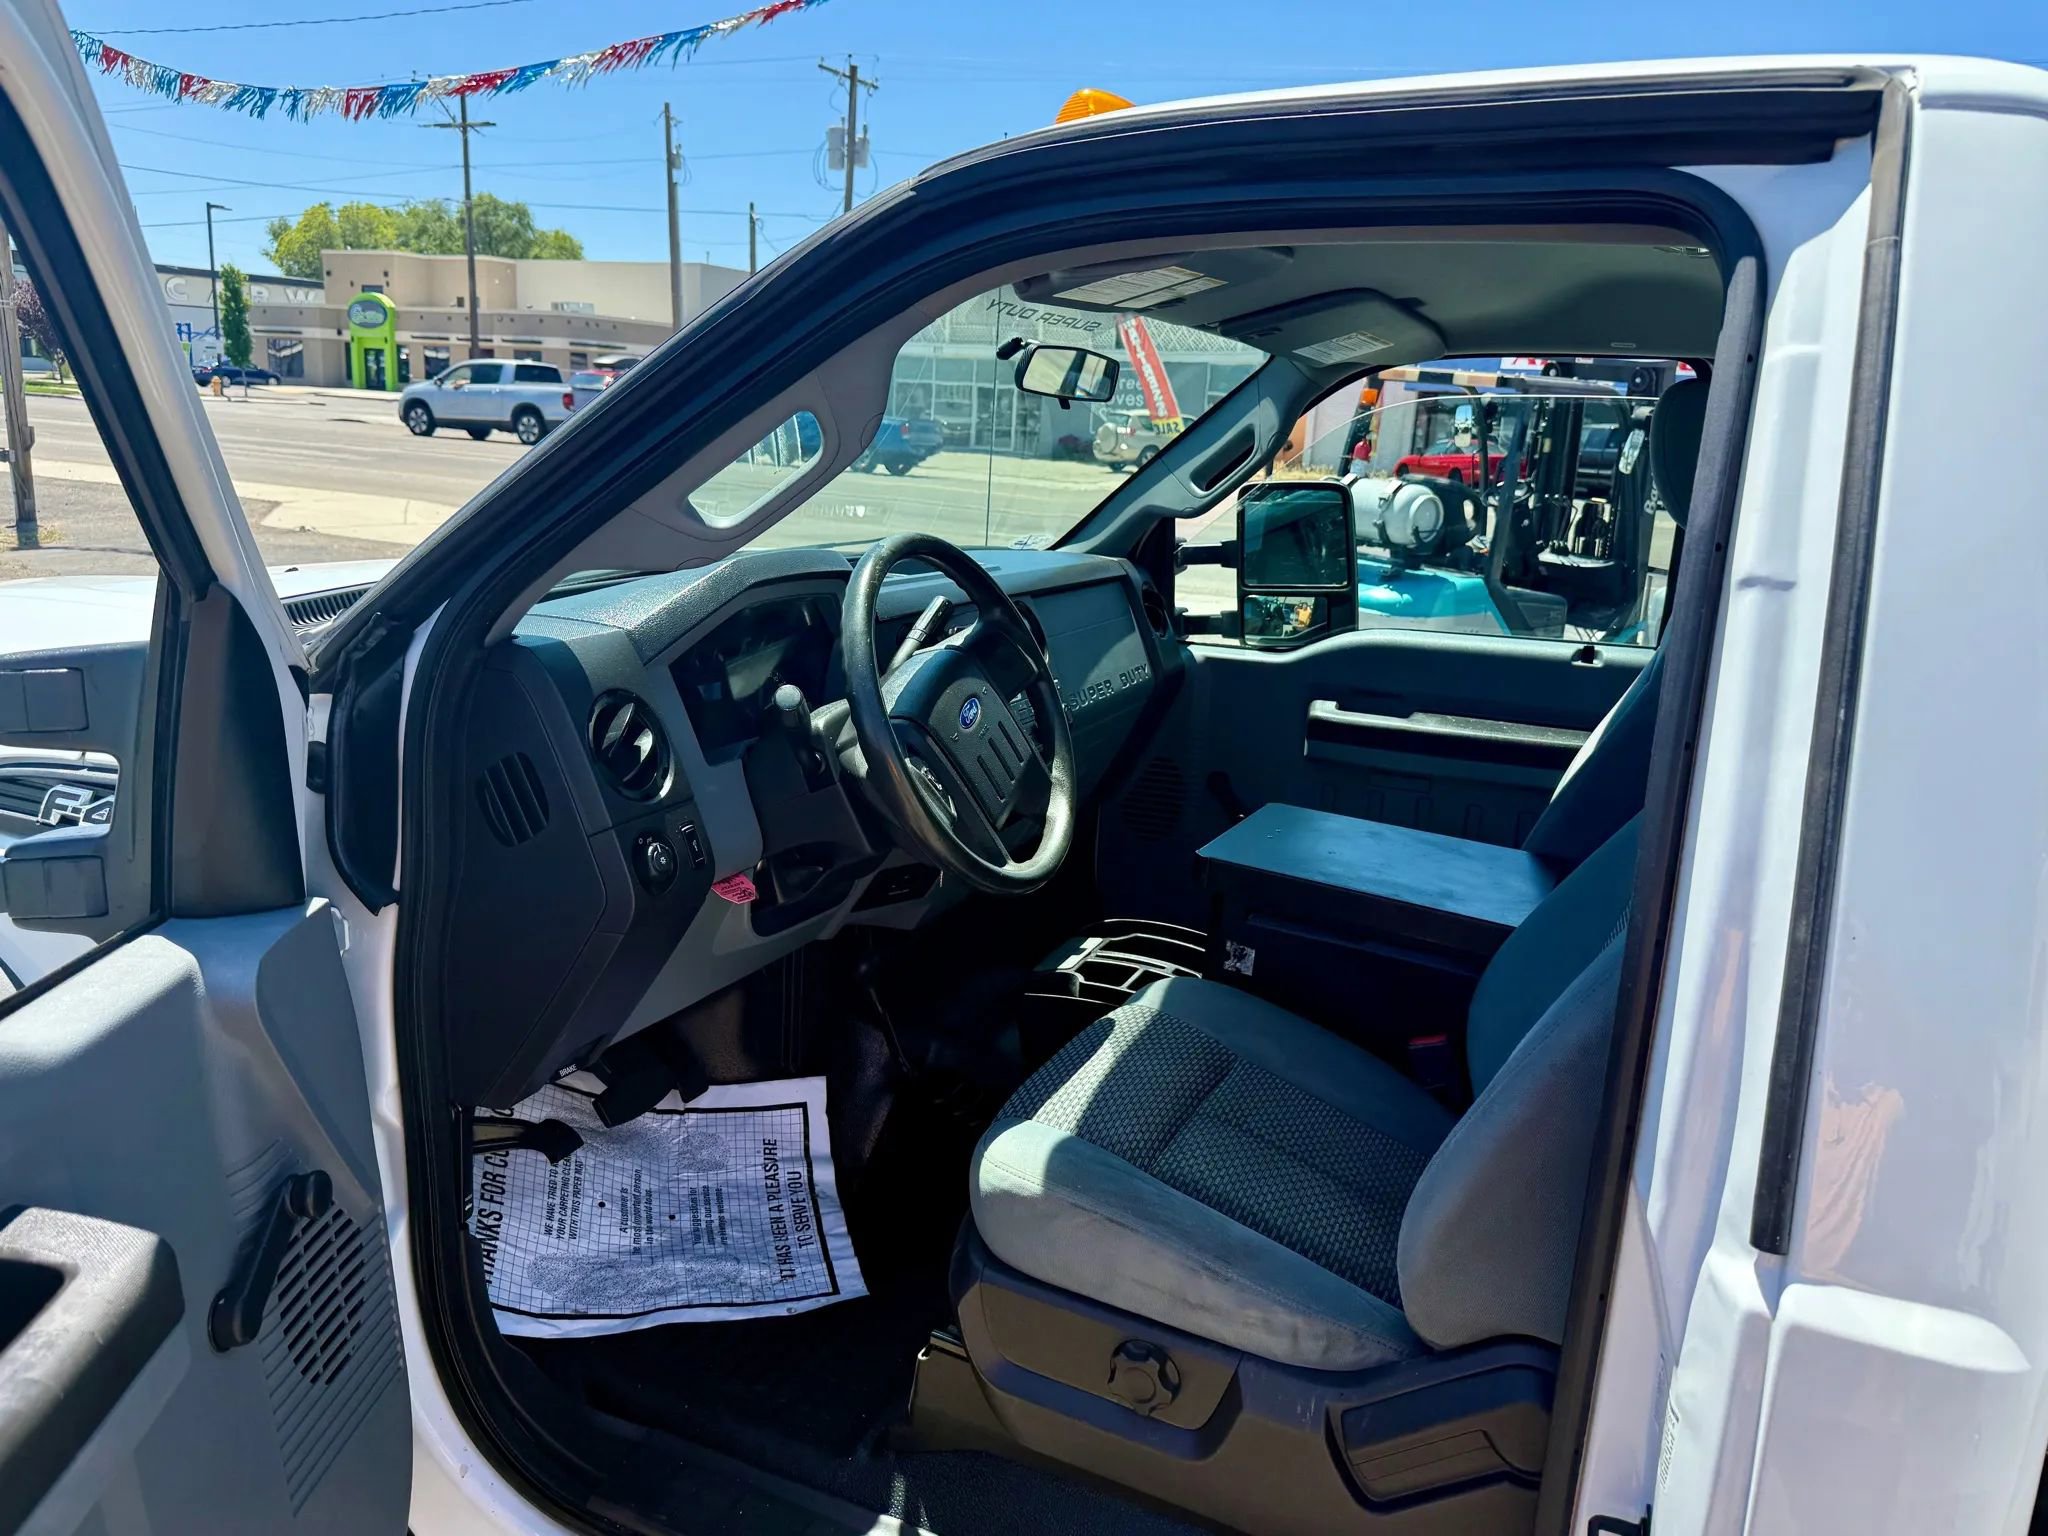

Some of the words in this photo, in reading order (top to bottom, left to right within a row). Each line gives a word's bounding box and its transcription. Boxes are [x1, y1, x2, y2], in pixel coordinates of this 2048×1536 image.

[1068, 679, 1115, 712] SUPER
[1118, 663, 1150, 690] DUTY
[559, 1063, 578, 1077] BRAKE
[549, 1168, 559, 1178] TO
[575, 1159, 584, 1176] MAT
[763, 1138, 782, 1202] PLEASURE
[480, 1170, 507, 1206] FOR
[547, 1179, 557, 1201] TRIED
[573, 1175, 582, 1199] PAPER
[633, 1168, 642, 1194] person
[787, 1170, 806, 1196] YOU
[558, 1176, 571, 1217] CARPETING
[546, 1200, 556, 1222] HAVE
[570, 1199, 581, 1218] THIS
[620, 1194, 629, 1226] customer
[768, 1203, 785, 1214] A
[790, 1197, 812, 1233] SERVE
[543, 1222, 554, 1236] WE
[556, 1217, 566, 1240] YOUR
[568, 1218, 579, 1240] WITH
[632, 1225, 641, 1245] most
[796, 1235, 815, 1249] TO
[774, 1244, 795, 1265] HAS
